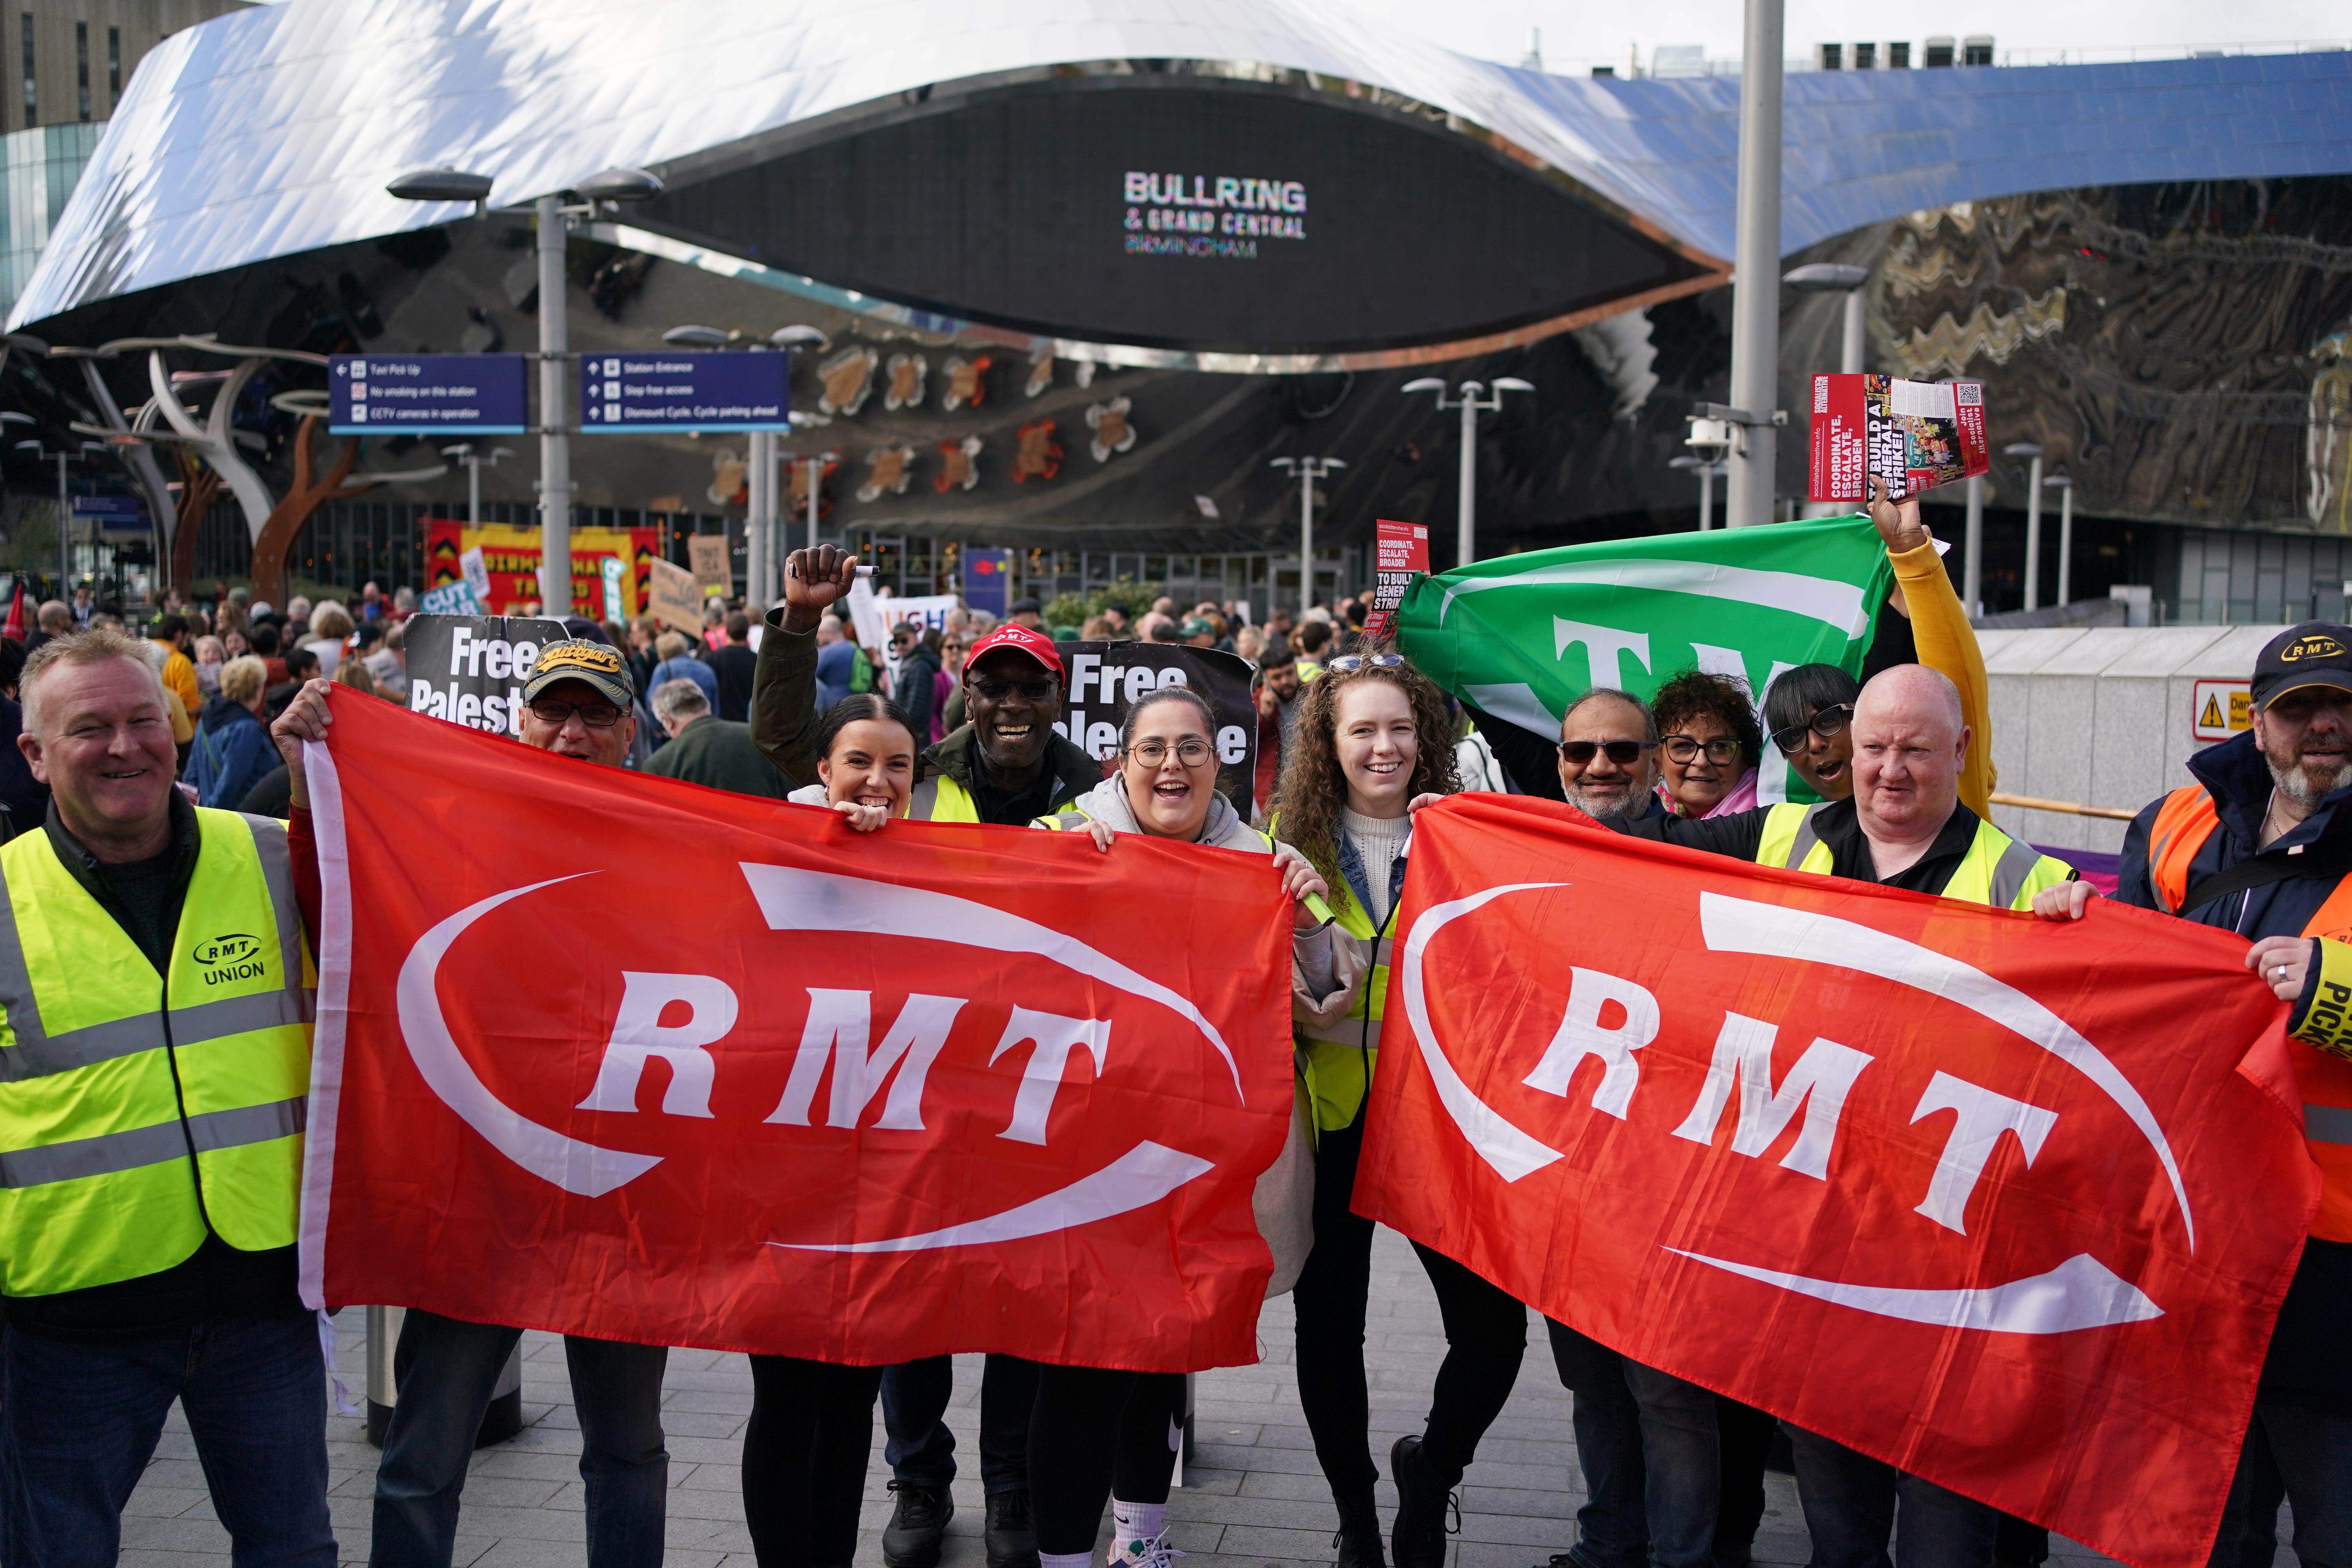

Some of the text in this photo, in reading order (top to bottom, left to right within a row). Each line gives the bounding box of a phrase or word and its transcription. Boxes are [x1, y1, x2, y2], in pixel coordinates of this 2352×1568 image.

[1124, 171, 1307, 213] BULLRING
[1124, 207, 1307, 240] & GRAND CENTRAL
[388, 363, 407, 376] Pick
[407, 363, 421, 377] Up
[624, 361, 694, 374] Station Entrance
[370, 386, 384, 397] No
[384, 386, 418, 399] smoking
[448, 386, 477, 397] station
[624, 383, 694, 397] Step free access
[370, 407, 480, 421] CCTV cameras in operation
[624, 407, 666, 419] Dismount
[693, 405, 719, 419] Cycle
[719, 405, 751, 419] parking
[751, 405, 779, 417] ahead
[1869, 404, 1880, 417] A
[1967, 408, 1976, 445] Socialist
[1974, 407, 1986, 454] Alternative
[1869, 420, 1882, 472] BUILD
[1831, 415, 1842, 498] COORDINATE,
[1842, 428, 1853, 498] ESCALATE,
[1852, 439, 1862, 497] BROADEN
[1892, 433, 1906, 500] STRIKE!
[1379, 539, 1414, 550] COORDINATE,
[1379, 549, 1410, 559] ESCALATE,
[1379, 558, 1406, 567] BROADEN
[1378, 573, 1390, 585] TO
[423, 582, 467, 611] CUT
[1377, 585, 1408, 597] GENER
[1374, 598, 1401, 609] STRIK
[884, 608, 945, 632] UGH
[451, 627, 539, 681] Free
[2292, 642, 2335, 656] RMT
[412, 679, 524, 736] Palest
[2231, 697, 2250, 710] Dan
[2231, 715, 2247, 724] Sheer
[209, 940, 249, 959] RMT
[204, 962, 265, 985] UNION
[574, 971, 1112, 1146] RMT
[1521, 965, 2060, 1237] RMT
